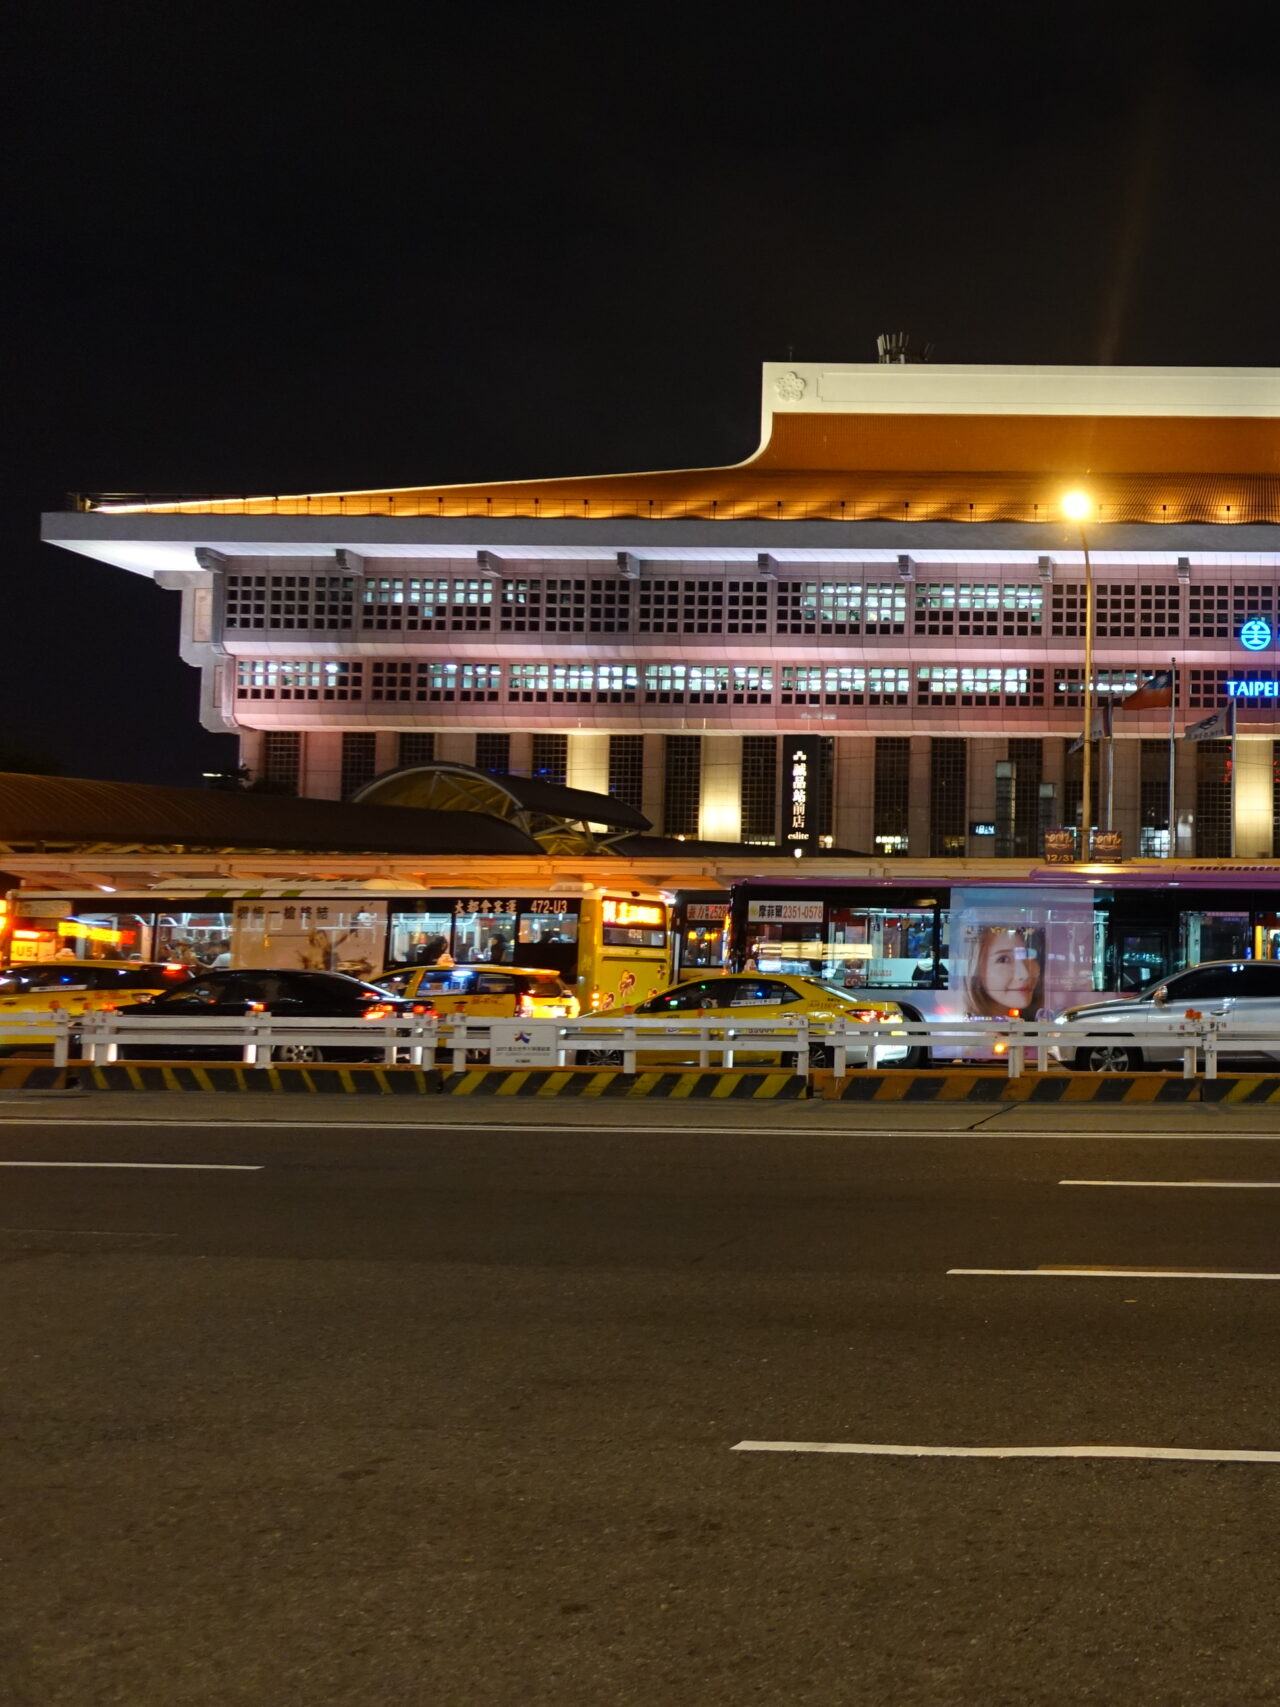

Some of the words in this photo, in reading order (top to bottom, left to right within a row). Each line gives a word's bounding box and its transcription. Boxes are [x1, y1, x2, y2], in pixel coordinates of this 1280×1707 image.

[1227, 681, 1279, 698] TAIPEI
[791, 762, 807, 828] 誠品站前店
[787, 831, 809, 841] eslite
[1046, 854, 1074, 862] 12/31
[530, 899, 568, 914] 472-U3
